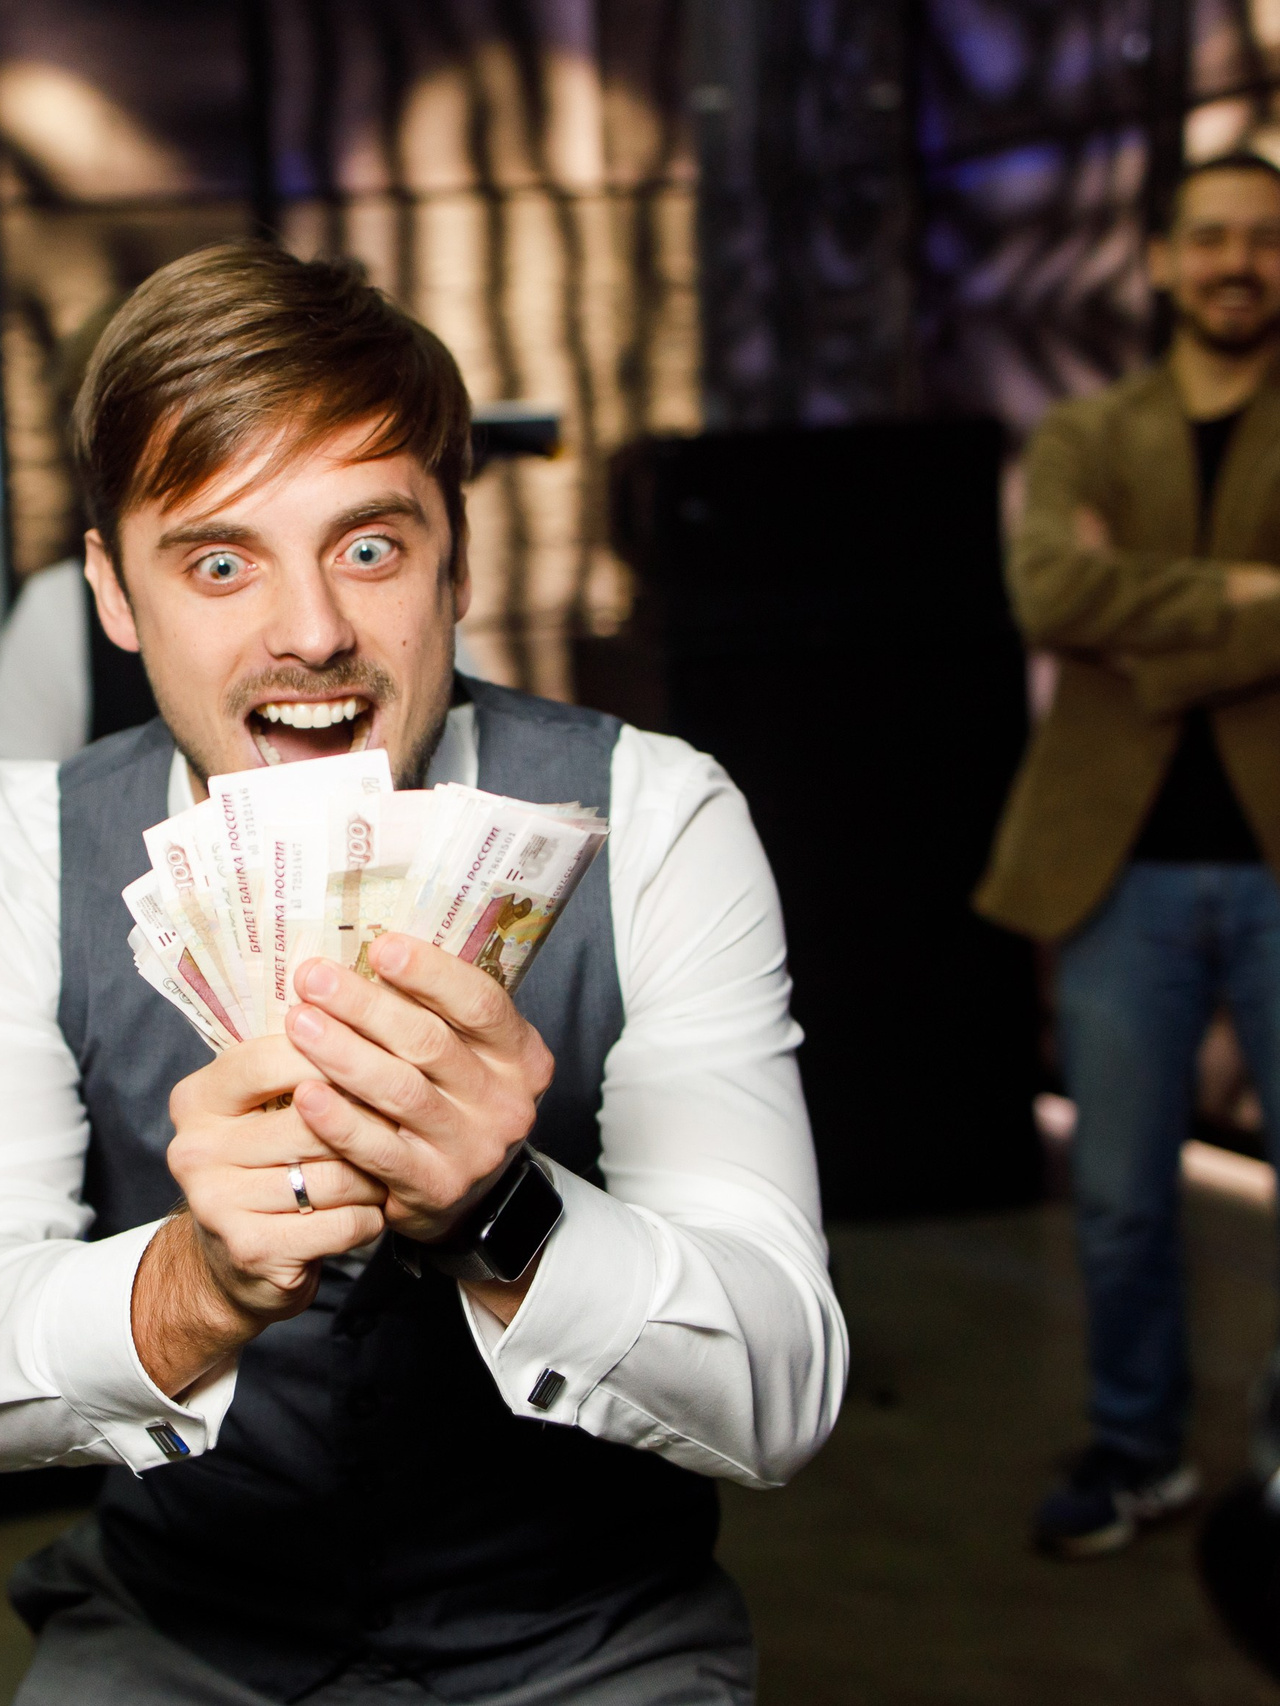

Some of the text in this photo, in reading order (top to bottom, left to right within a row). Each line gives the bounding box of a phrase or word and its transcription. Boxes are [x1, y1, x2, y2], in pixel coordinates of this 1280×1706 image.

[221, 792, 242, 851] РОССИИ
[347, 820, 372, 865] 100
[167, 849, 195, 889] 100
[233, 856, 253, 904] БАНКА
[441, 826, 501, 930] БАНКА РОССИИ
[243, 908, 263, 953] БИЛЕТ
[274, 841, 288, 1001] БИЛЕТ БАНКА РОССИИ
